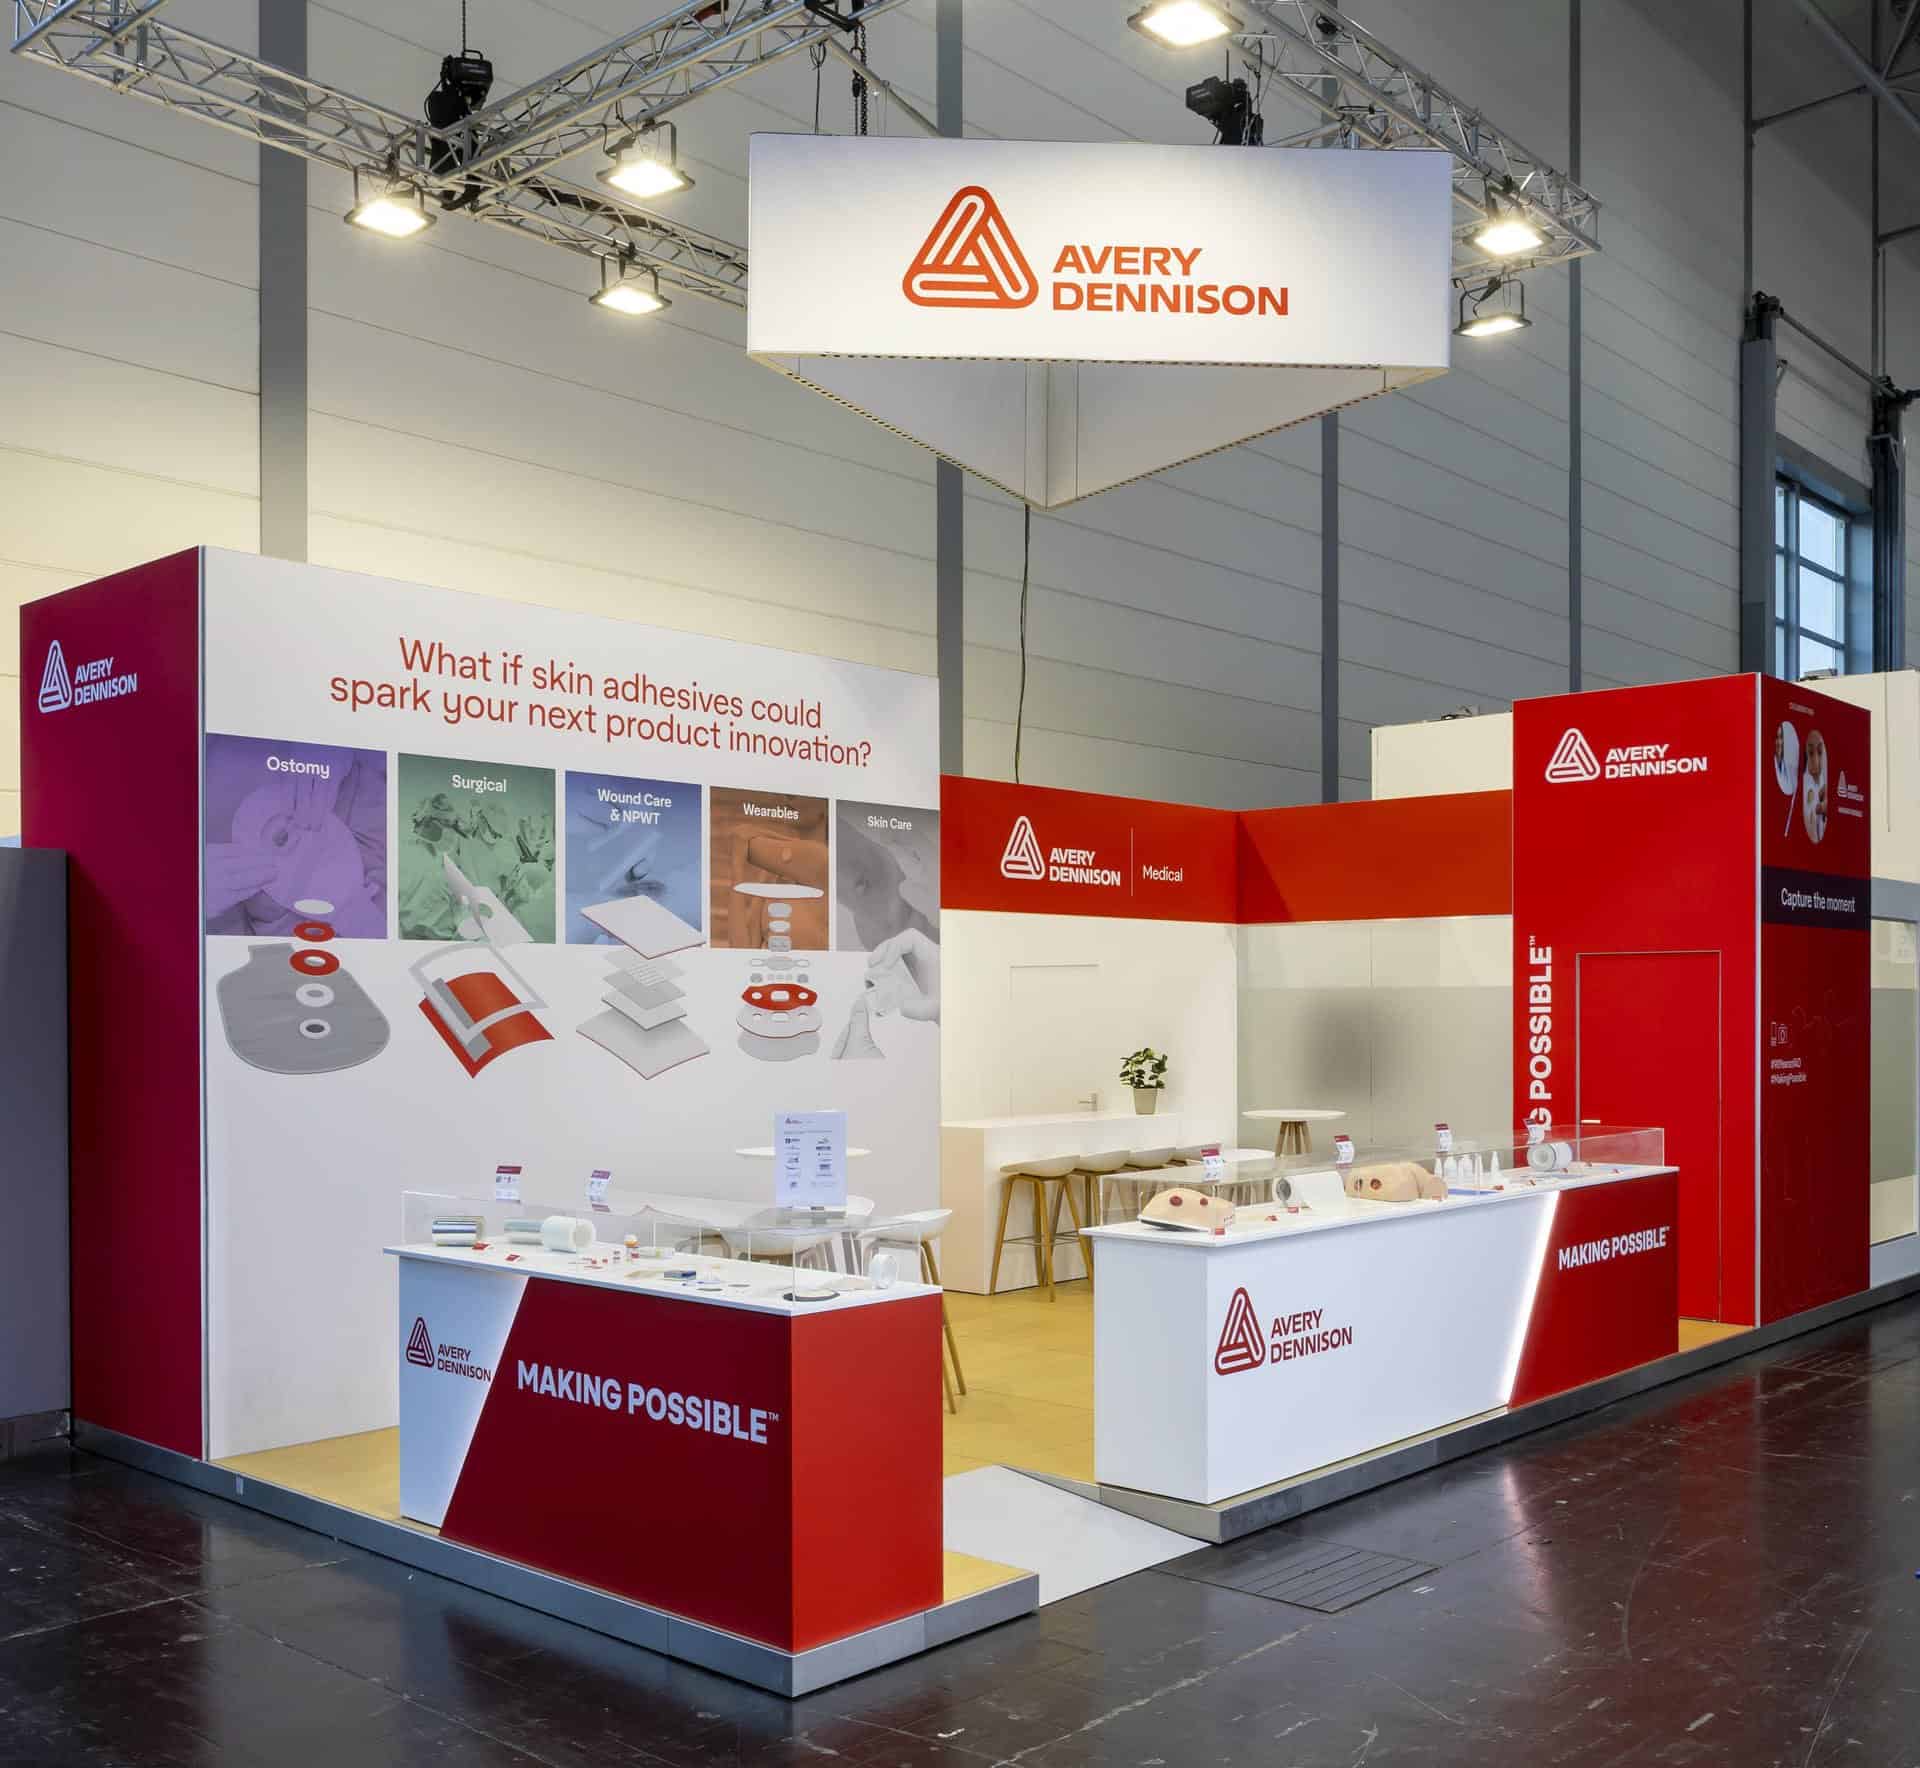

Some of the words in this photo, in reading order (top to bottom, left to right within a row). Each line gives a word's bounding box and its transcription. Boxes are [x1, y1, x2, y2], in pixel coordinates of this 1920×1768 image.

[1052, 245, 1203, 276] AVERY
[1052, 281, 1289, 316] DENNISON
[74, 656, 114, 685] AVERY
[399, 636, 492, 683] What
[502, 651, 524, 686] if
[532, 659, 594, 697] skin
[603, 672, 744, 718] adhesives
[751, 699, 822, 729] could
[74, 672, 138, 706] DENNISON
[330, 676, 431, 713] spark
[443, 691, 519, 725] your
[528, 702, 597, 734] next
[606, 713, 721, 750] product
[729, 721, 872, 768] innovation?
[1605, 743, 1670, 763] AVERY
[266, 756, 330, 780] Ostomy
[1605, 756, 1708, 779] DENNISON
[451, 774, 507, 794] Surgical
[597, 788, 642, 806] Wound
[644, 792, 673, 808] Care
[609, 809, 619, 822] &
[622, 809, 661, 825] NPWT
[743, 802, 799, 822] Wearables
[866, 815, 888, 830] Skin
[889, 817, 912, 832] Care
[1049, 847, 1096, 866] AVERY
[1049, 866, 1121, 887] DENNISON
[1142, 865, 1184, 882] Medical
[1780, 887, 1812, 911] Capture
[1813, 891, 1826, 910] the
[1826, 897, 1856, 913] moment
[1558, 1238, 1610, 1271] MAKING
[1271, 1308, 1323, 1339] AVERY
[437, 1343, 472, 1362] AVERY
[1270, 1326, 1353, 1364] DENNISON
[437, 1358, 492, 1382] DENNISON
[517, 1359, 622, 1411] MAKING
